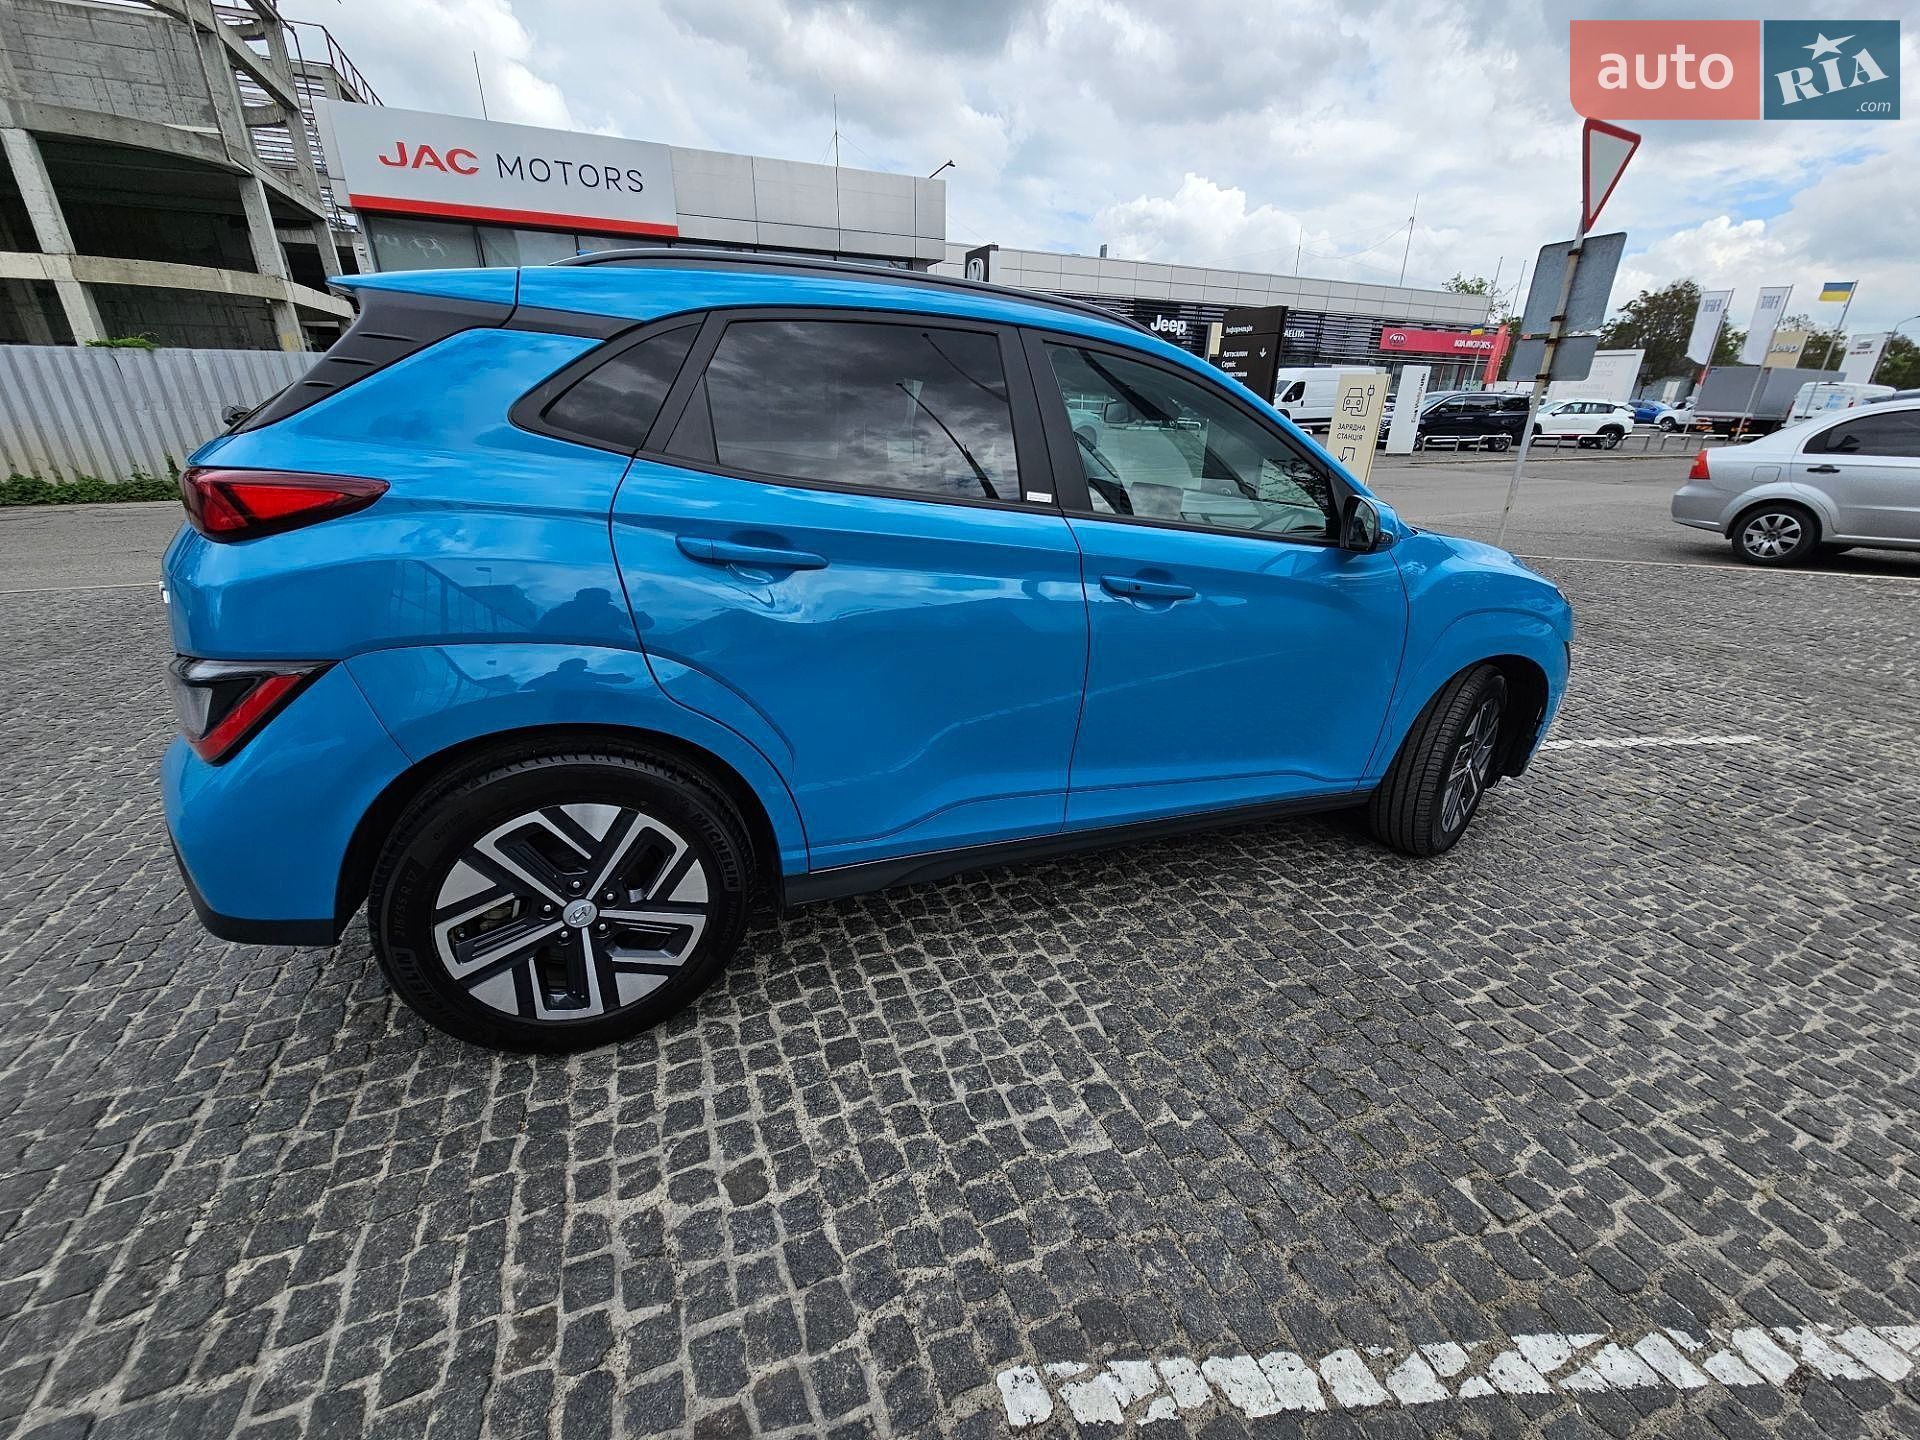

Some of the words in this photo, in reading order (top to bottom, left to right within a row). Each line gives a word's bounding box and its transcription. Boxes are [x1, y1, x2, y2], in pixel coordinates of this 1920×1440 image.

[378, 141, 480, 176] JAC
[496, 153, 644, 193] MOTORS
[1150, 314, 1187, 336] Jeep
[1284, 329, 1305, 338] AELITA
[1466, 340, 1491, 350] MOTORS
[1770, 343, 1799, 354] Jeep
[1223, 350, 1249, 358] Автосалон
[1337, 422, 1367, 432] ЗАРЯДНА
[1336, 432, 1363, 442] СТАНЦІЯ
[691, 811, 739, 888] MICHELIN
